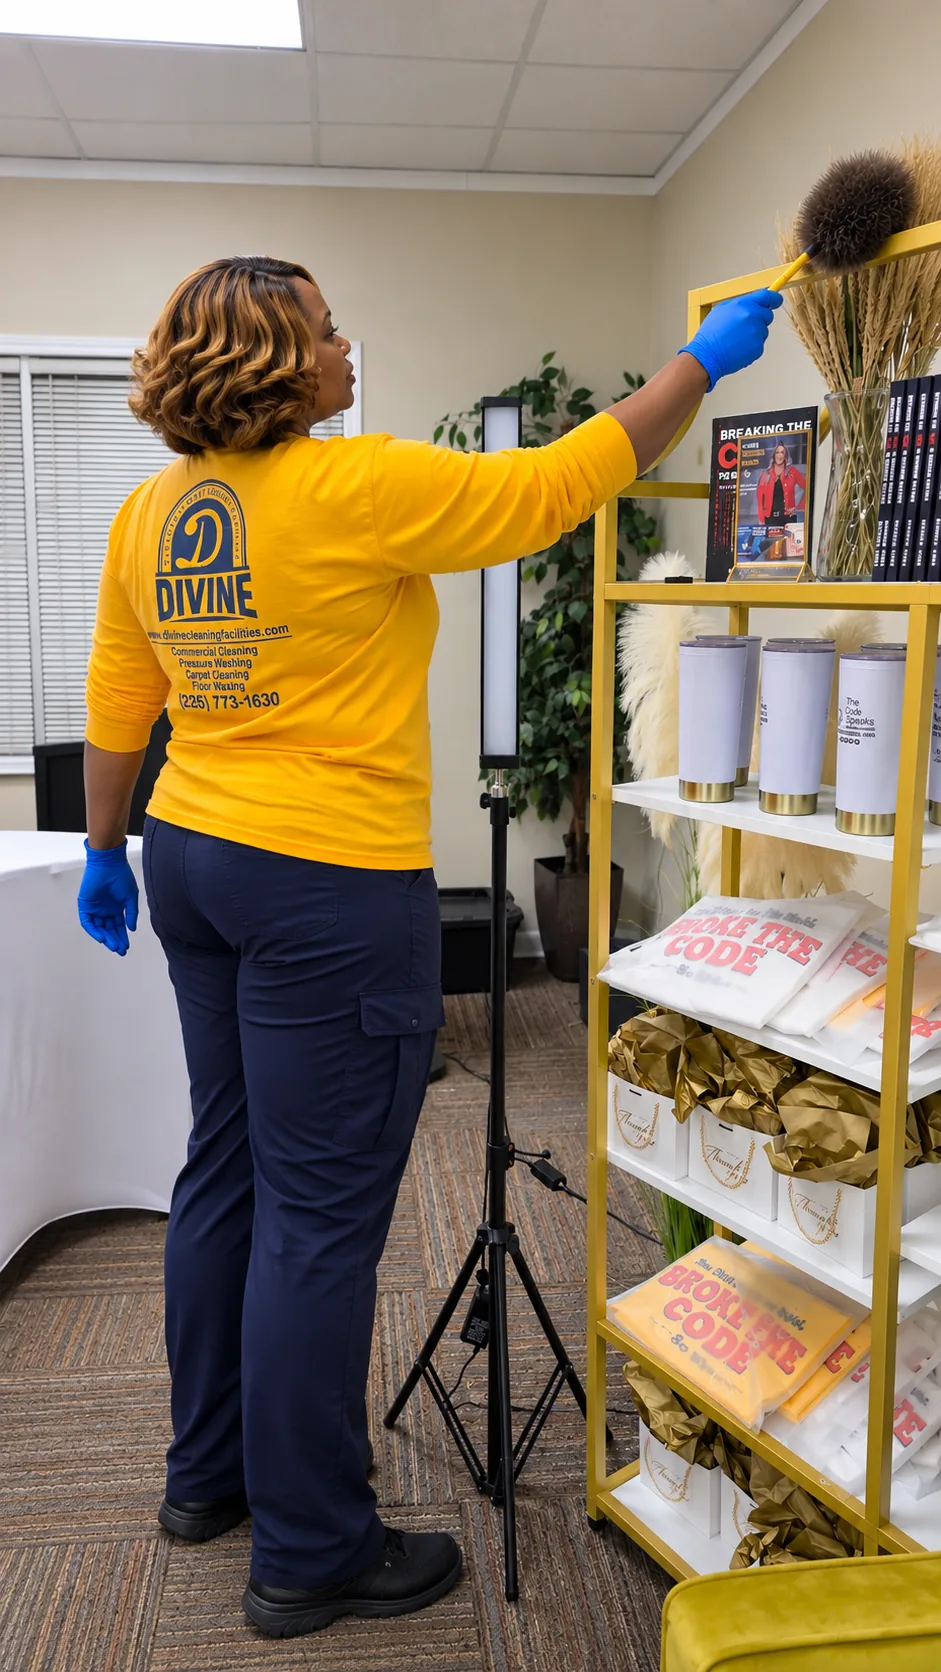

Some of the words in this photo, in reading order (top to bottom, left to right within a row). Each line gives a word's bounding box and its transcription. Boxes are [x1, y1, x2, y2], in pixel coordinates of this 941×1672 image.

[720, 423, 784, 440] BREAKING
[155, 572, 258, 622] DIVINE
[171, 646, 217, 656] Commercial
[192, 681, 212, 691] Floor
[179, 693, 210, 712] (225)
[212, 691, 280, 710] 773-1630
[845, 706, 862, 716] Code
[846, 697, 860, 707] The
[752, 921, 823, 966] THE
[664, 935, 768, 976] CODE
[658, 1264, 758, 1331] BROKE
[663, 1297, 751, 1375] CODE
